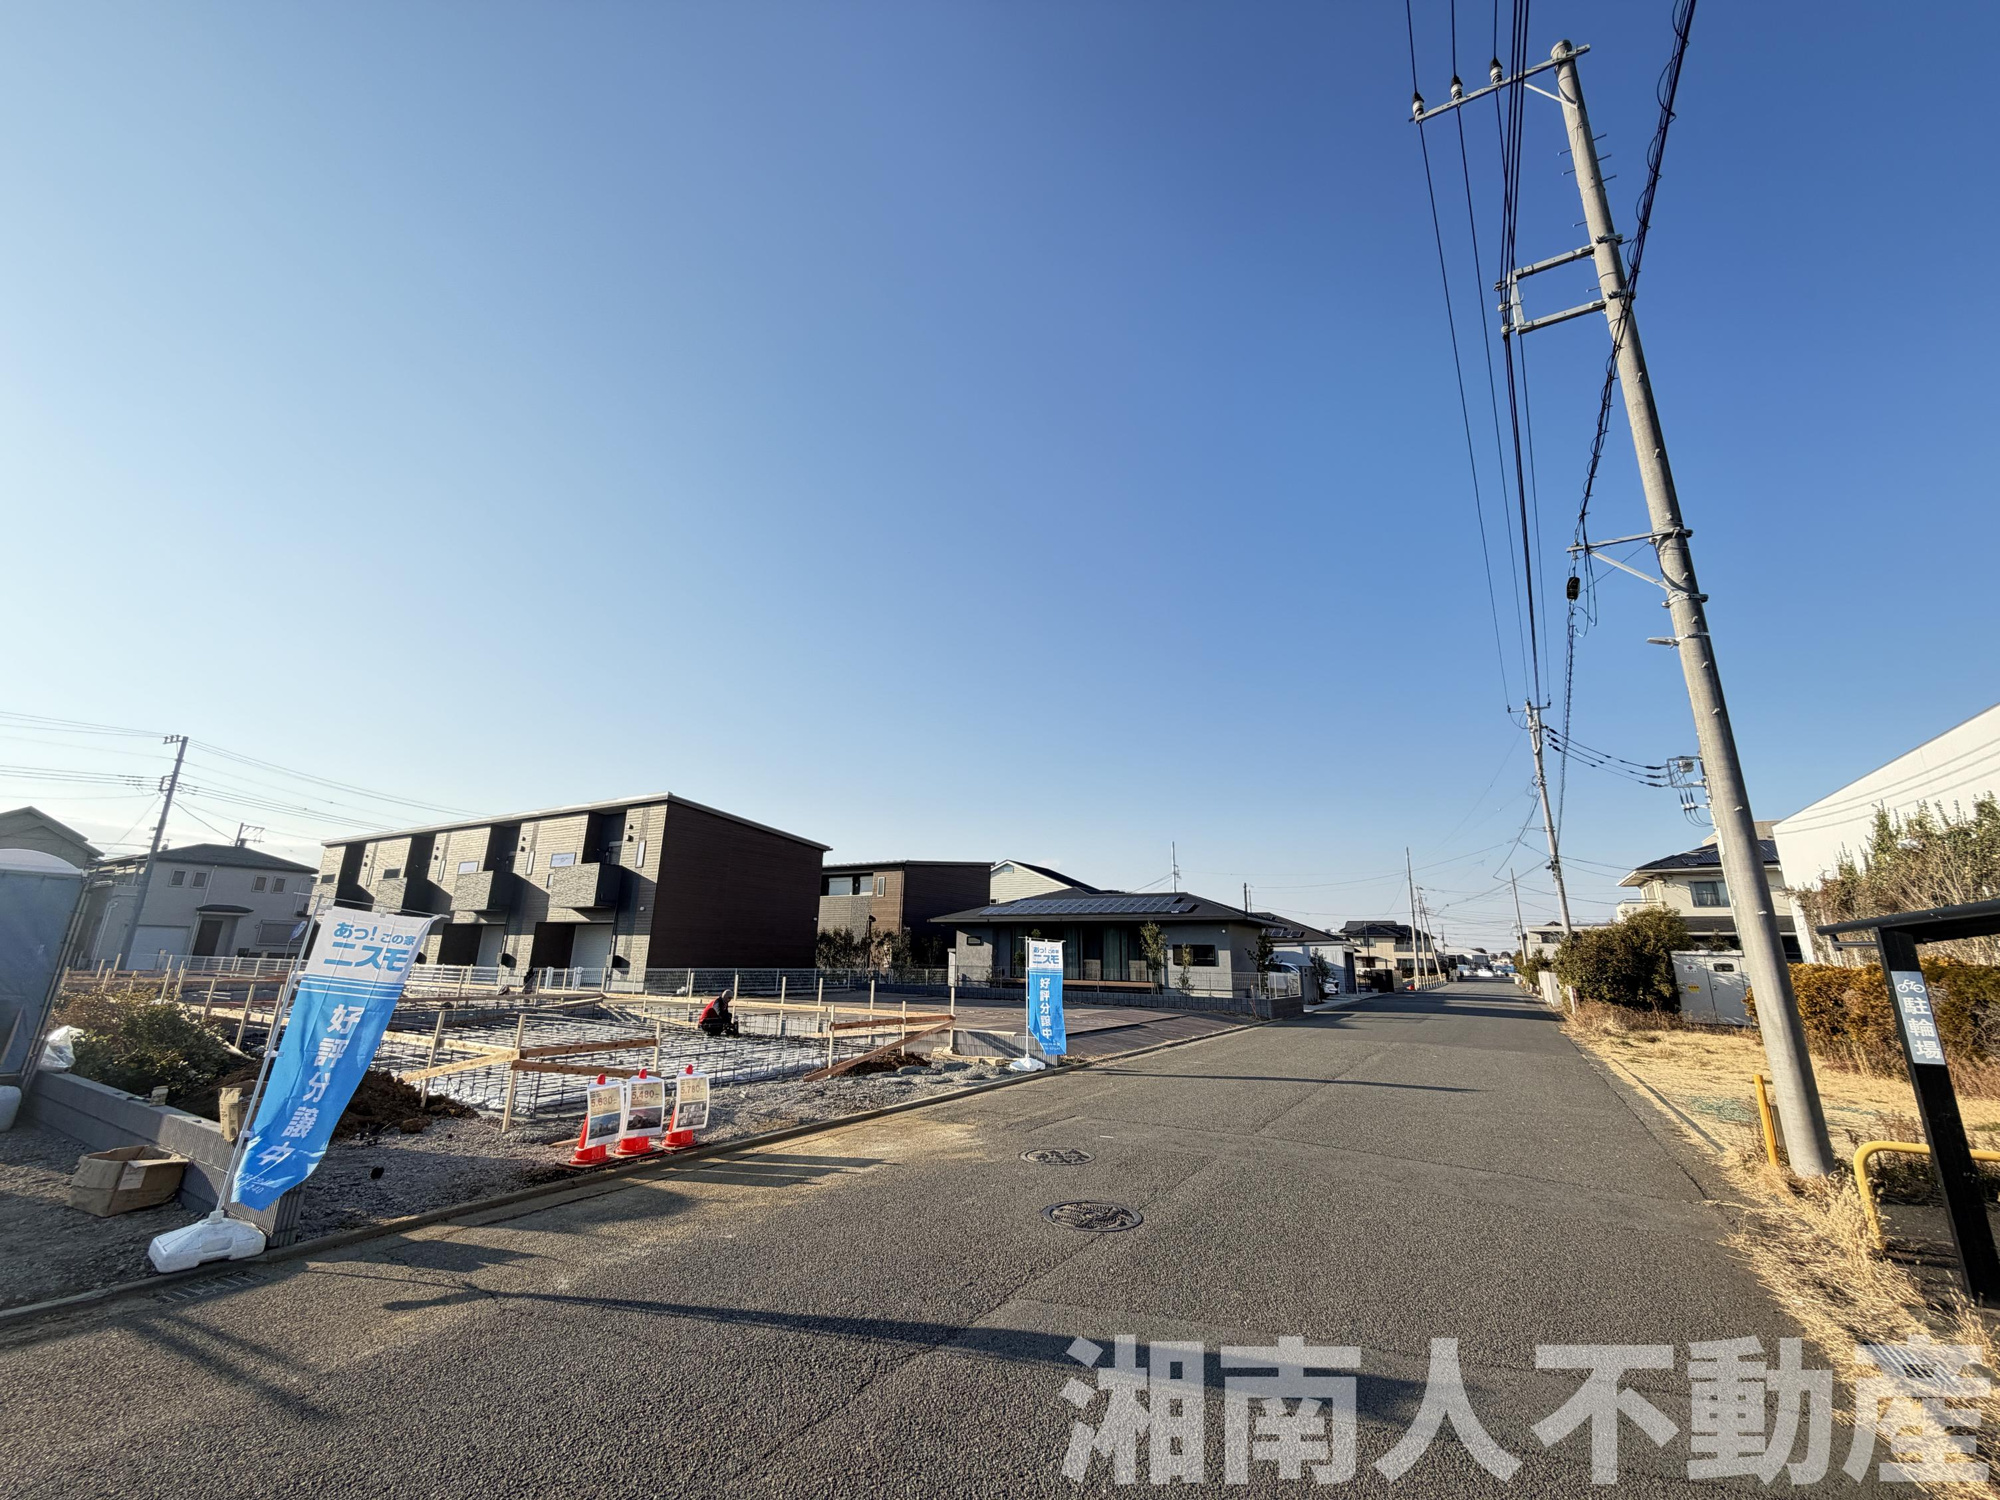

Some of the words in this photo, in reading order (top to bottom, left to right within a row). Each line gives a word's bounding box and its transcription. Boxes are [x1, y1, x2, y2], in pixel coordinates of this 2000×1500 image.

[323, 941, 410, 972] ニスモ
[1033, 954, 1059, 964] ニスモ
[1902, 997, 1941, 1059] 駐輪場
[257, 1003, 364, 1165] 好評分譲中
